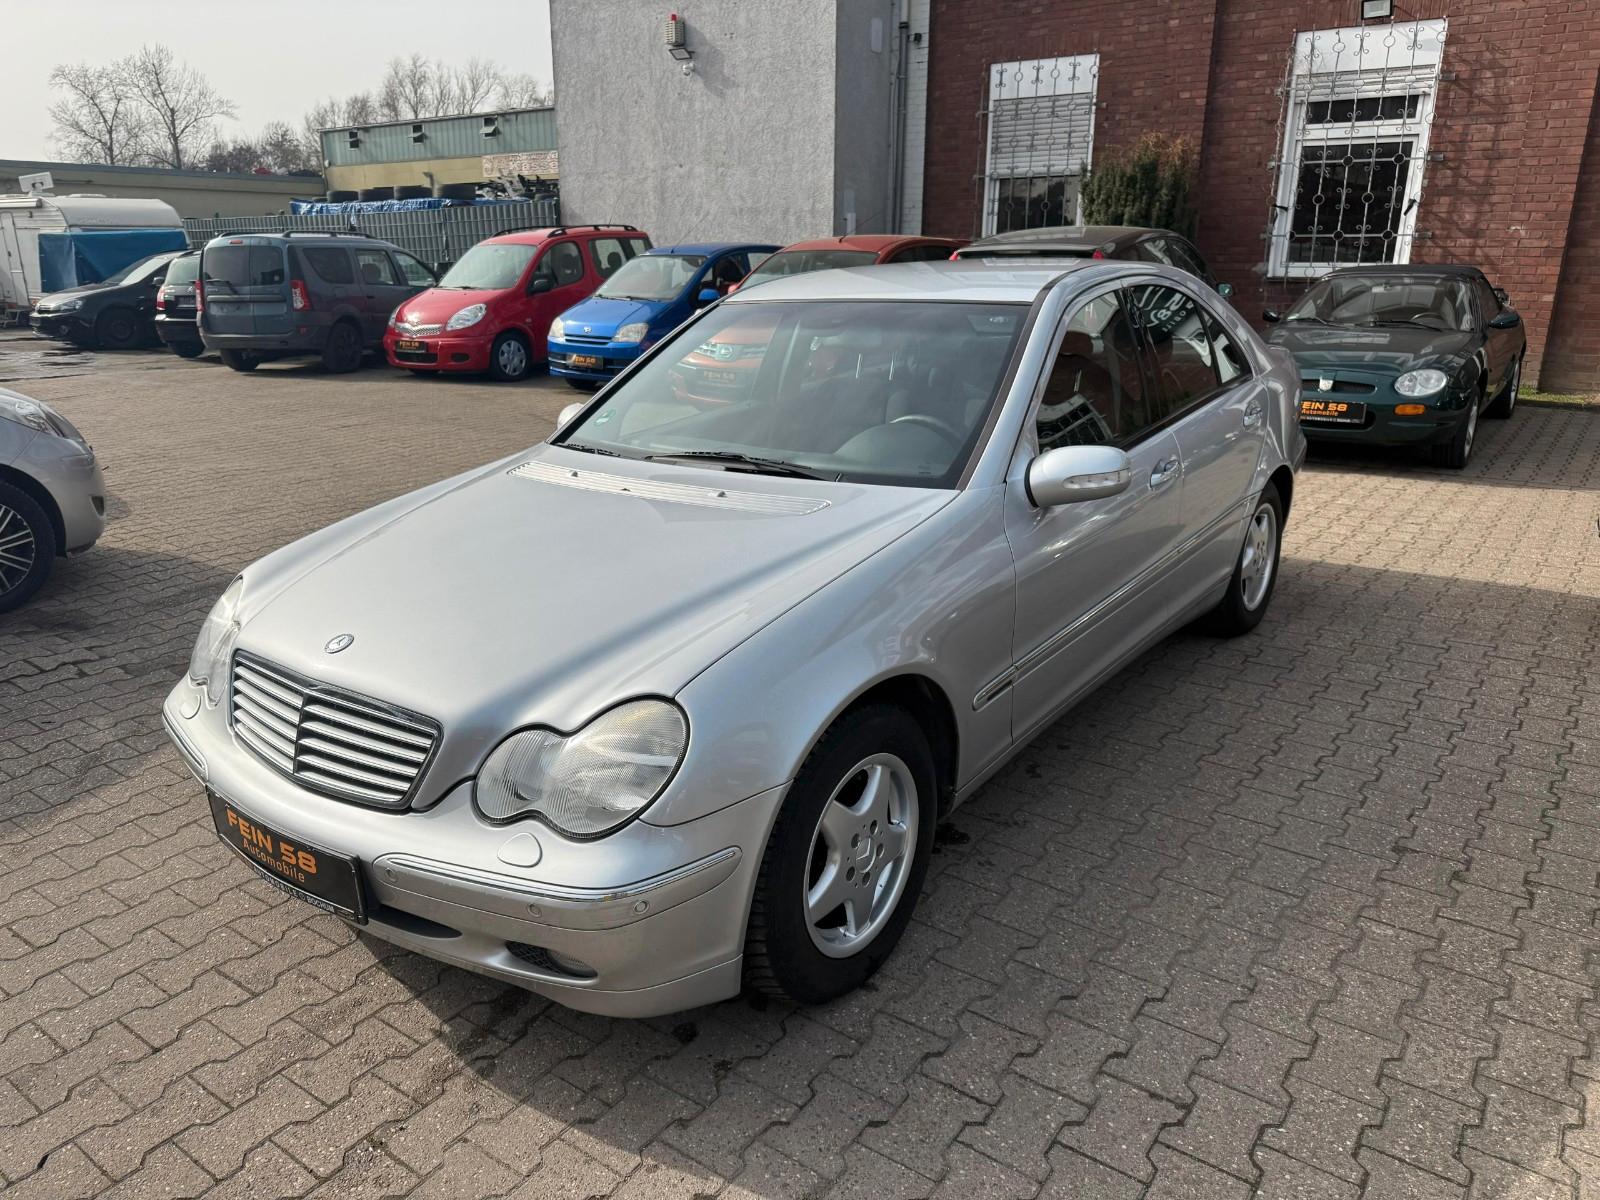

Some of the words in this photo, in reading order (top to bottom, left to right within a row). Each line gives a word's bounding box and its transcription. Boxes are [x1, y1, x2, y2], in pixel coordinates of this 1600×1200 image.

[1301, 401, 1325, 410] EIN
[1327, 402, 1349, 412] 58
[226, 808, 273, 853] FEIN
[279, 841, 317, 874] 58
[243, 838, 305, 883] Automobile
